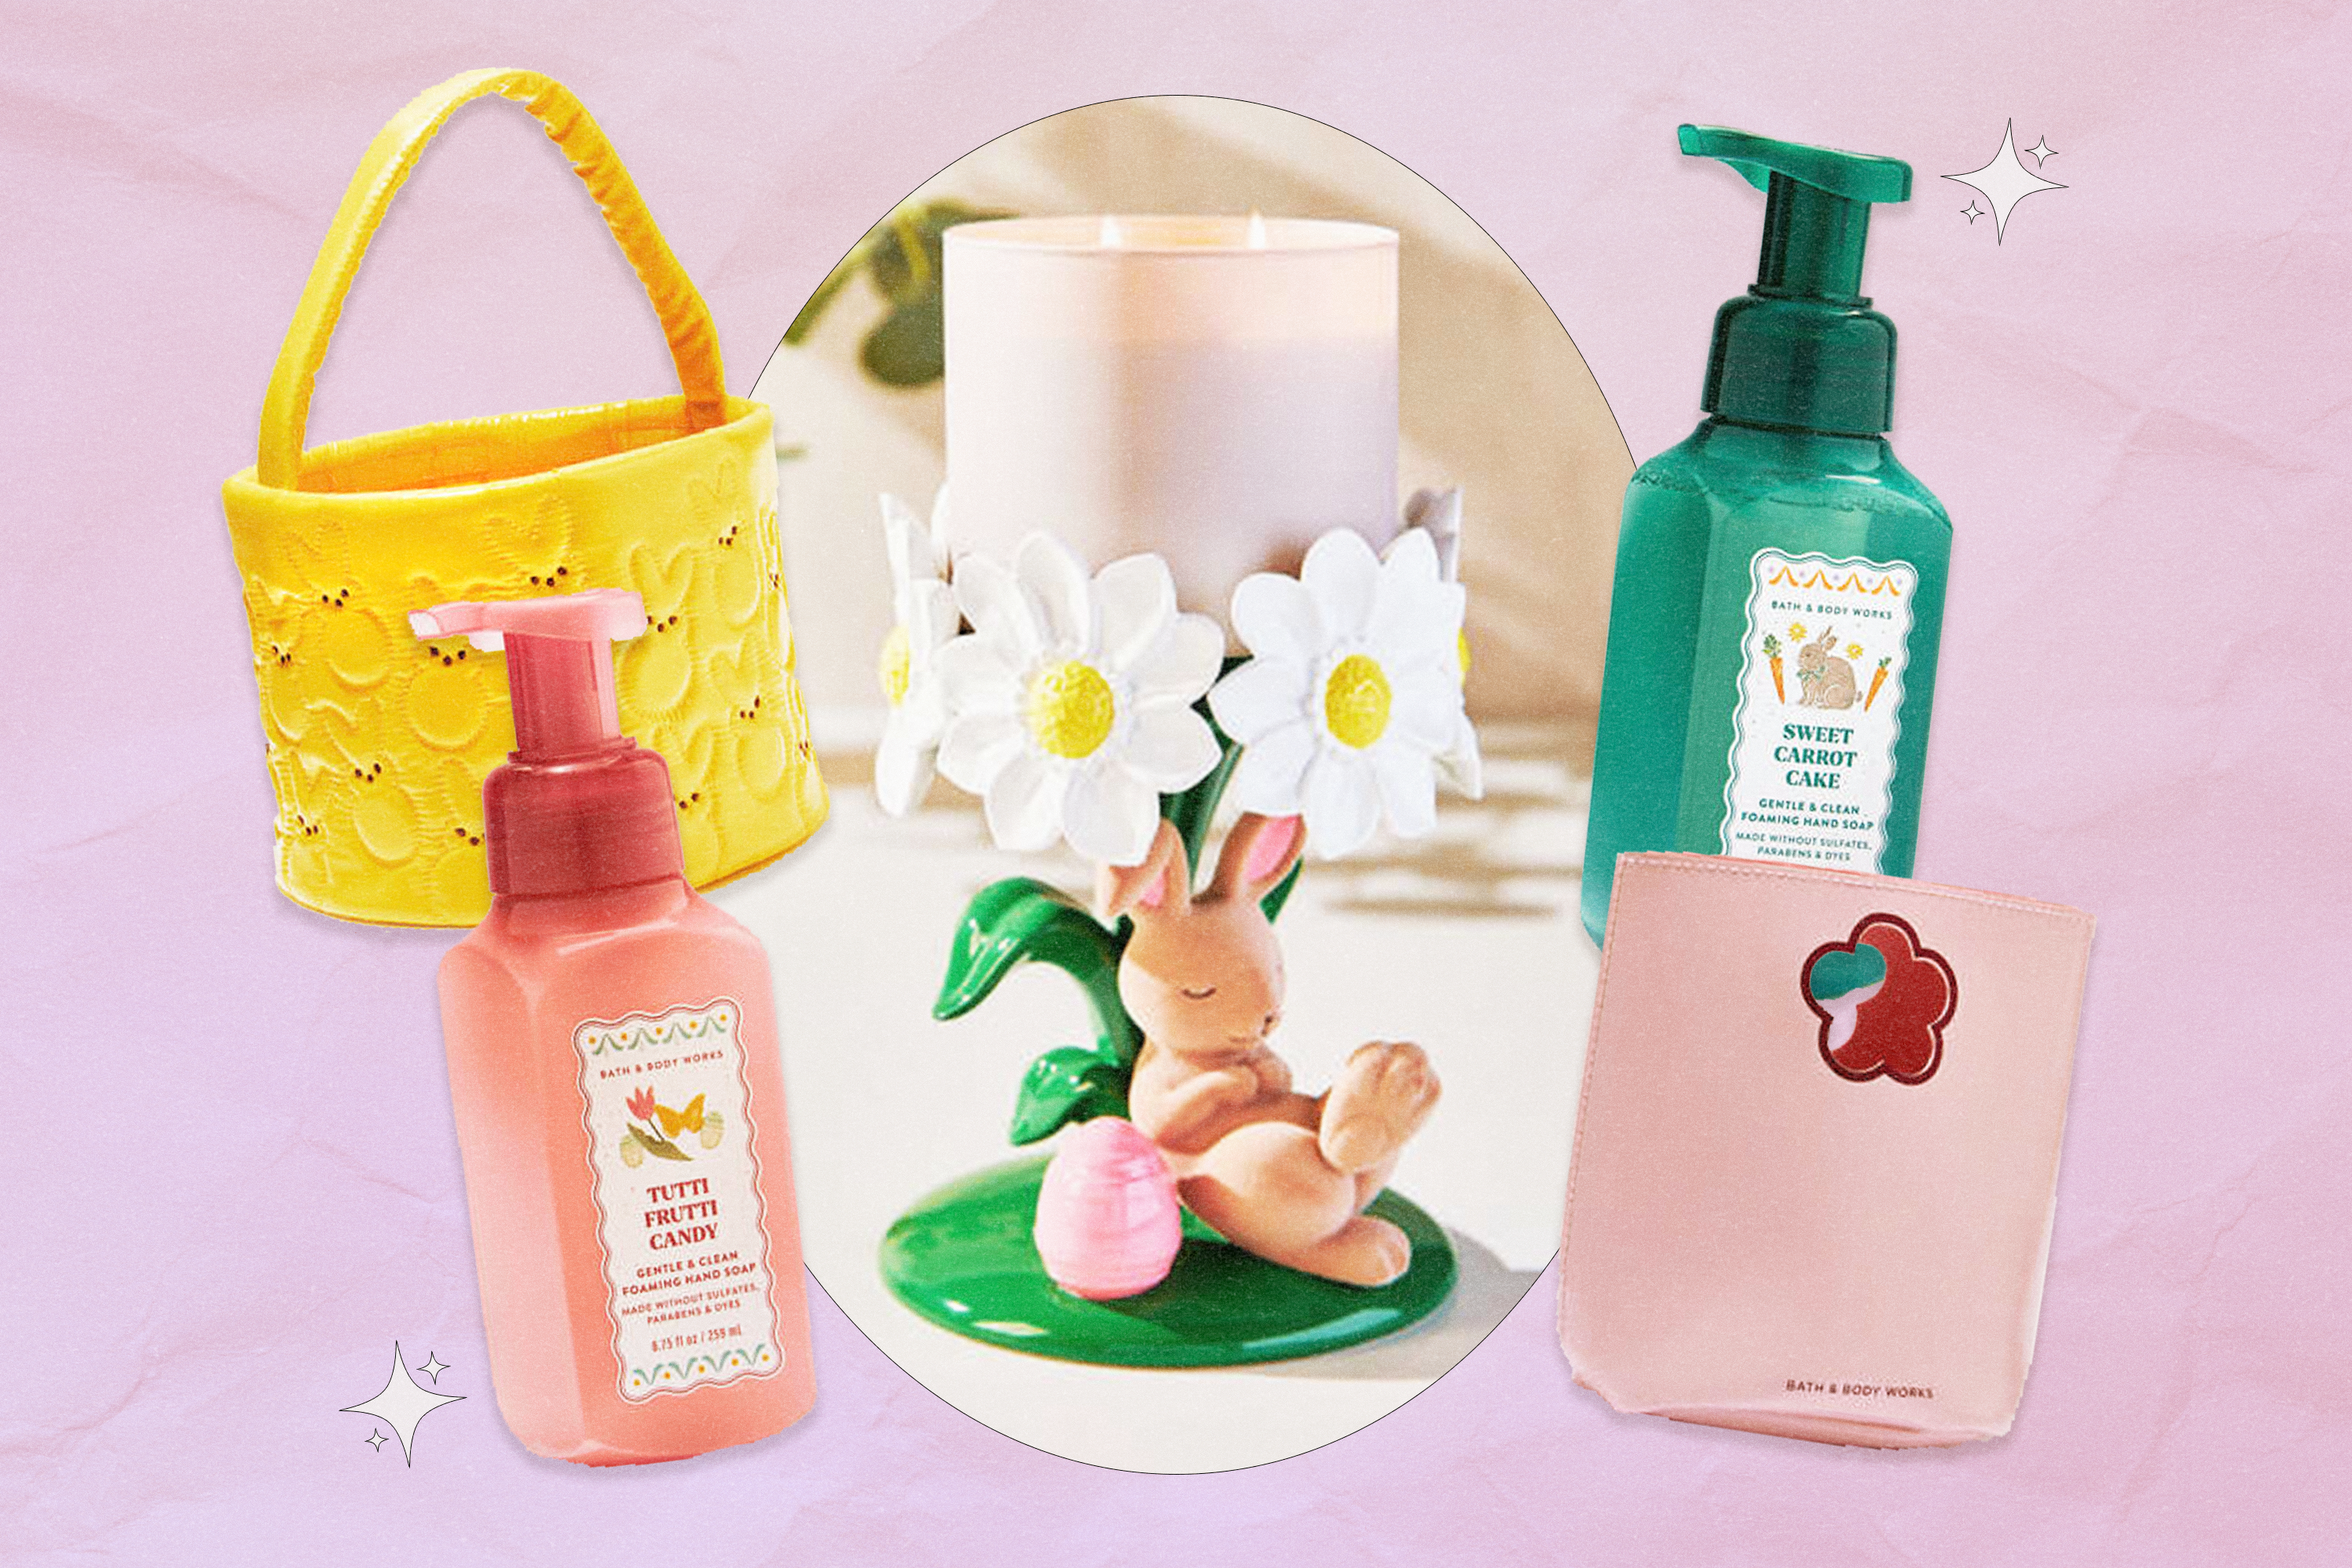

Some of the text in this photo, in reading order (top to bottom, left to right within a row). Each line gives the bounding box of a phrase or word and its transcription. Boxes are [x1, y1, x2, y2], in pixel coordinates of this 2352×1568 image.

[1772, 601, 1893, 619] BATH & BODY WORKS
[1783, 723, 1854, 744] SWEET
[1773, 746, 1857, 768] CARROT
[1786, 770, 1841, 789] CAKE
[1759, 798, 1860, 815] GENTLE & CLEAN
[1740, 812, 1874, 830] FOAMING HAND SOAP
[1736, 833, 1766, 842] MADE
[1769, 835, 1817, 846] WITHOUT
[1757, 847, 1812, 858] PARABENS
[1826, 851, 1850, 861] DYES
[600, 1067, 630, 1080] BATH
[647, 1059, 679, 1071] BODY
[684, 1050, 724, 1064] WORKS
[646, 1178, 710, 1203] TUTTI
[644, 1200, 718, 1228] FRUTTI
[649, 1222, 718, 1250] CANDY
[636, 1250, 739, 1279] GENTLE & CLEAN
[622, 1263, 757, 1296] FOAMING HAND SOAP
[622, 1303, 652, 1316] MADE
[655, 1294, 703, 1310] WITHOUT
[647, 1308, 702, 1324] PARABENS
[714, 1299, 741, 1312] DYES
[686, 1333, 698, 1345] oz
[1786, 1379, 1933, 1399] BATH & BODY WORKS
